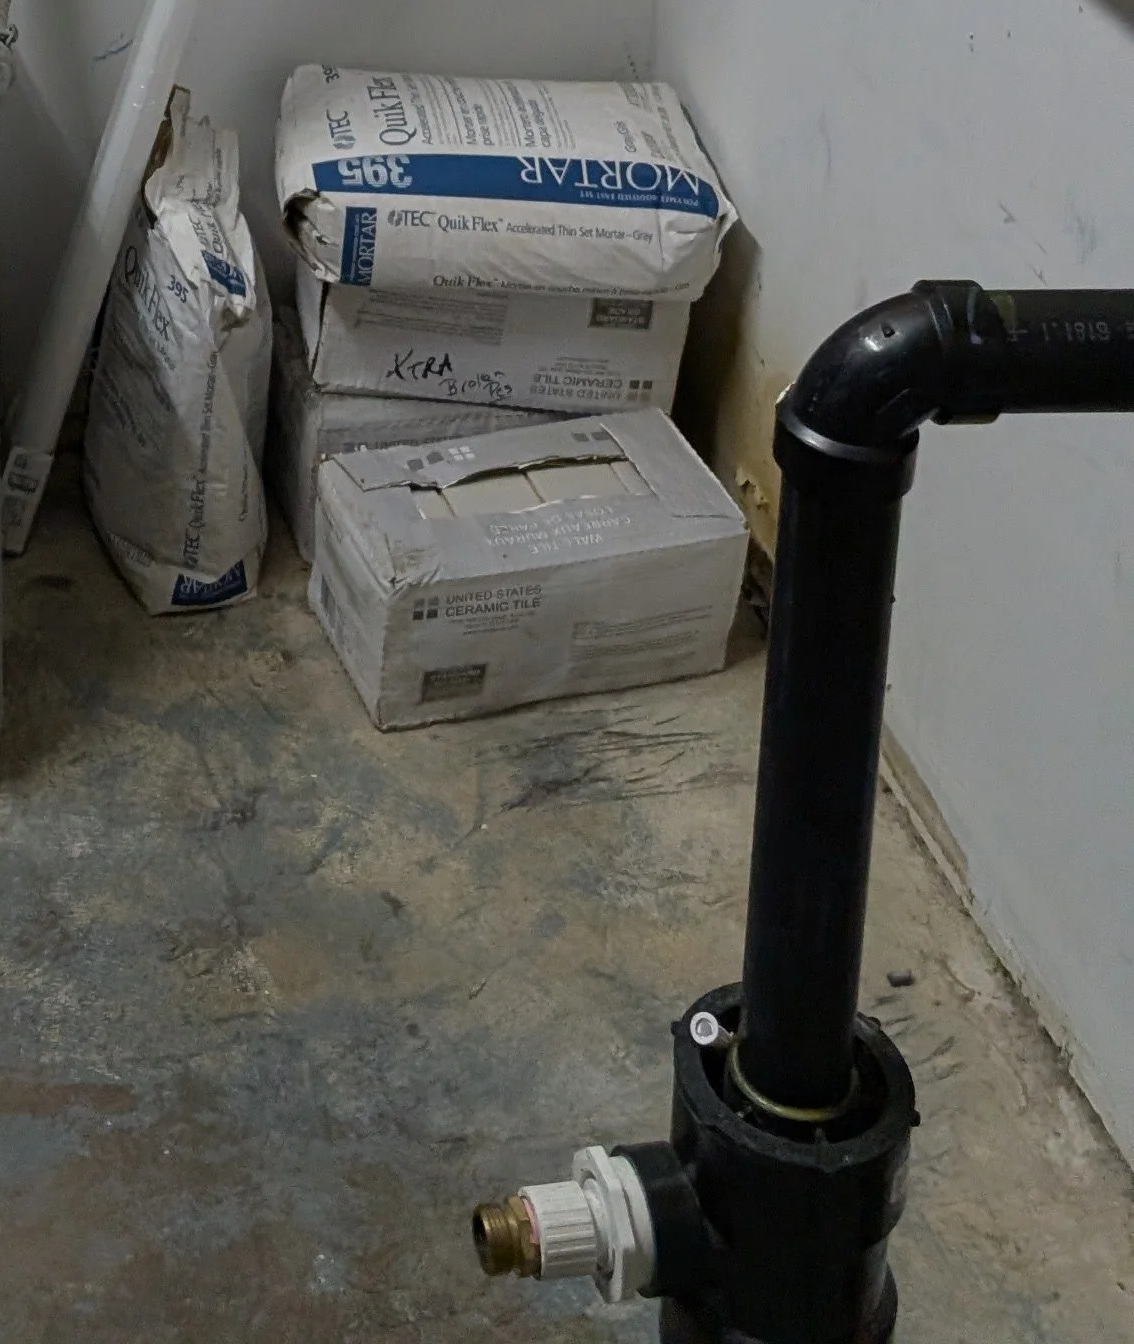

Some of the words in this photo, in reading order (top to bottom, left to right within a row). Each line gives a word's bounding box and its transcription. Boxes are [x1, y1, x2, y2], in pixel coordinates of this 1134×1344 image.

[325, 109, 352, 138] TEC
[373, 101, 417, 146] Quik
[338, 154, 413, 189] 395
[519, 155, 701, 196] MORTAR
[401, 210, 431, 227] TEC
[437, 213, 470, 233] Quik
[557, 223, 577, 236] Thin
[578, 226, 593, 238] Set
[356, 212, 377, 284] MORTAR
[167, 273, 190, 304] 395
[385, 347, 453, 381] XTRA
[529, 385, 575, 399] STATES
[532, 373, 561, 385] TILE
[562, 376, 623, 389] CERAMIC
[576, 389, 622, 401] UNITED
[445, 601, 510, 618] CERAMIC
[513, 598, 541, 610] TILE
[446, 590, 493, 605] UNITED
[496, 584, 542, 599] STATES
